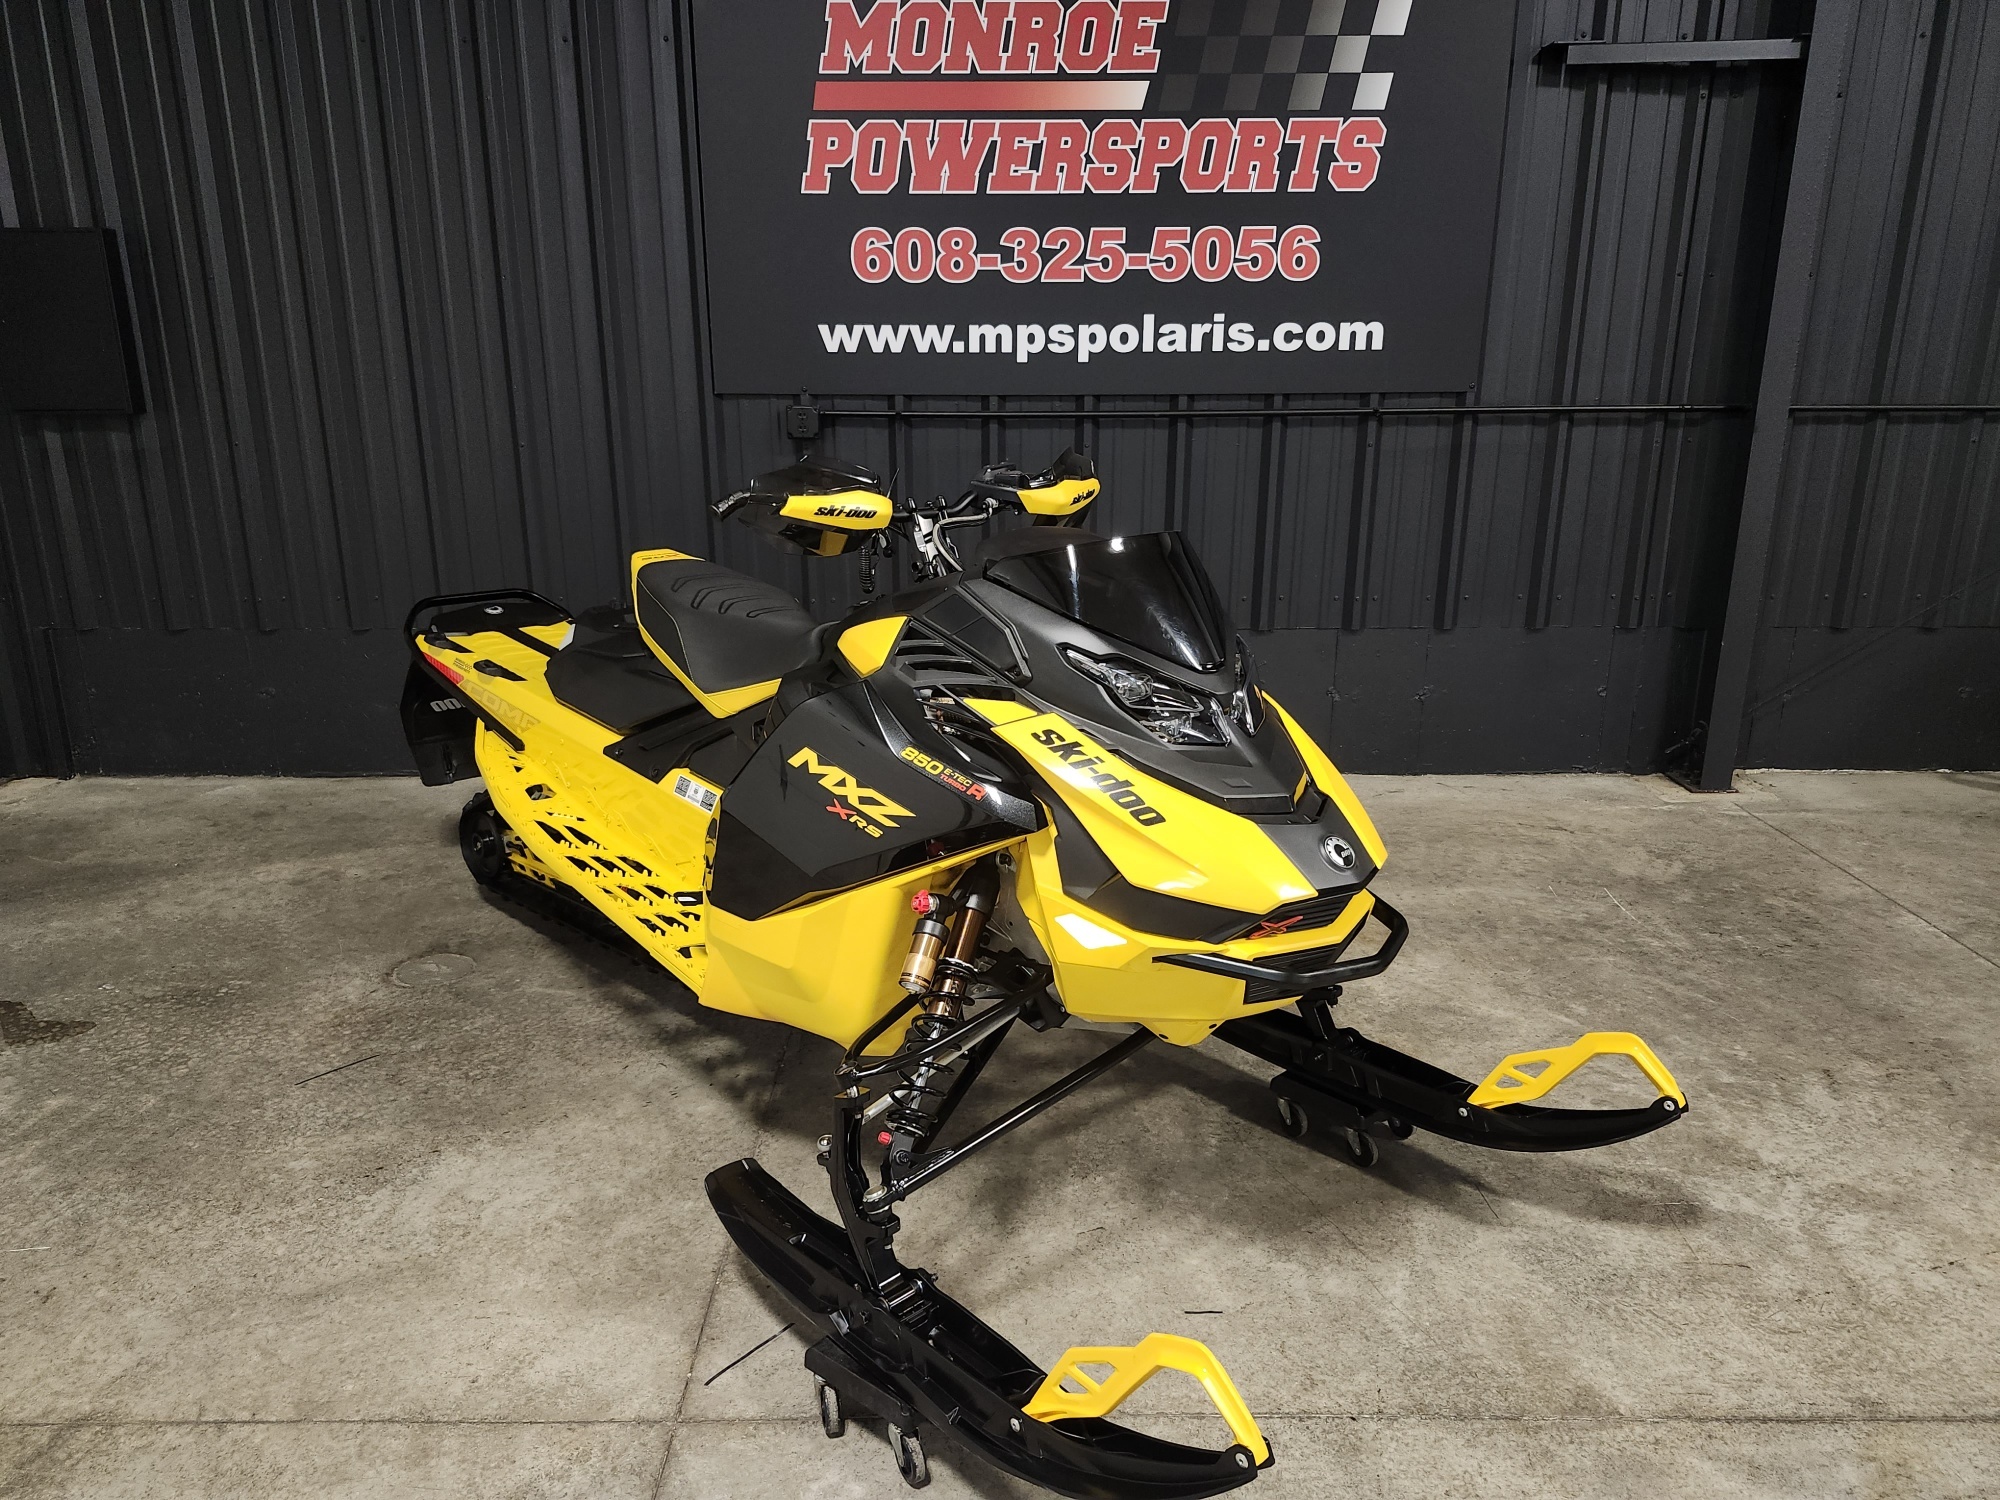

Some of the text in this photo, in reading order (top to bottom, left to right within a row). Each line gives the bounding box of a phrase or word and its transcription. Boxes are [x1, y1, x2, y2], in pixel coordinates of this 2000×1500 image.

[819, 0, 1169, 74] MONROE
[801, 117, 1386, 194] POWERSPORTS
[851, 225, 1321, 284] 608-325-5056
[818, 314, 1385, 363] www.mpspolaris.com
[813, 504, 878, 519] ski-doo
[787, 746, 917, 828] MXZ
[900, 746, 945, 775] 850
[943, 768, 973, 787] E-TEC
[1030, 728, 1167, 827] ski-doo
[966, 783, 987, 801] R
